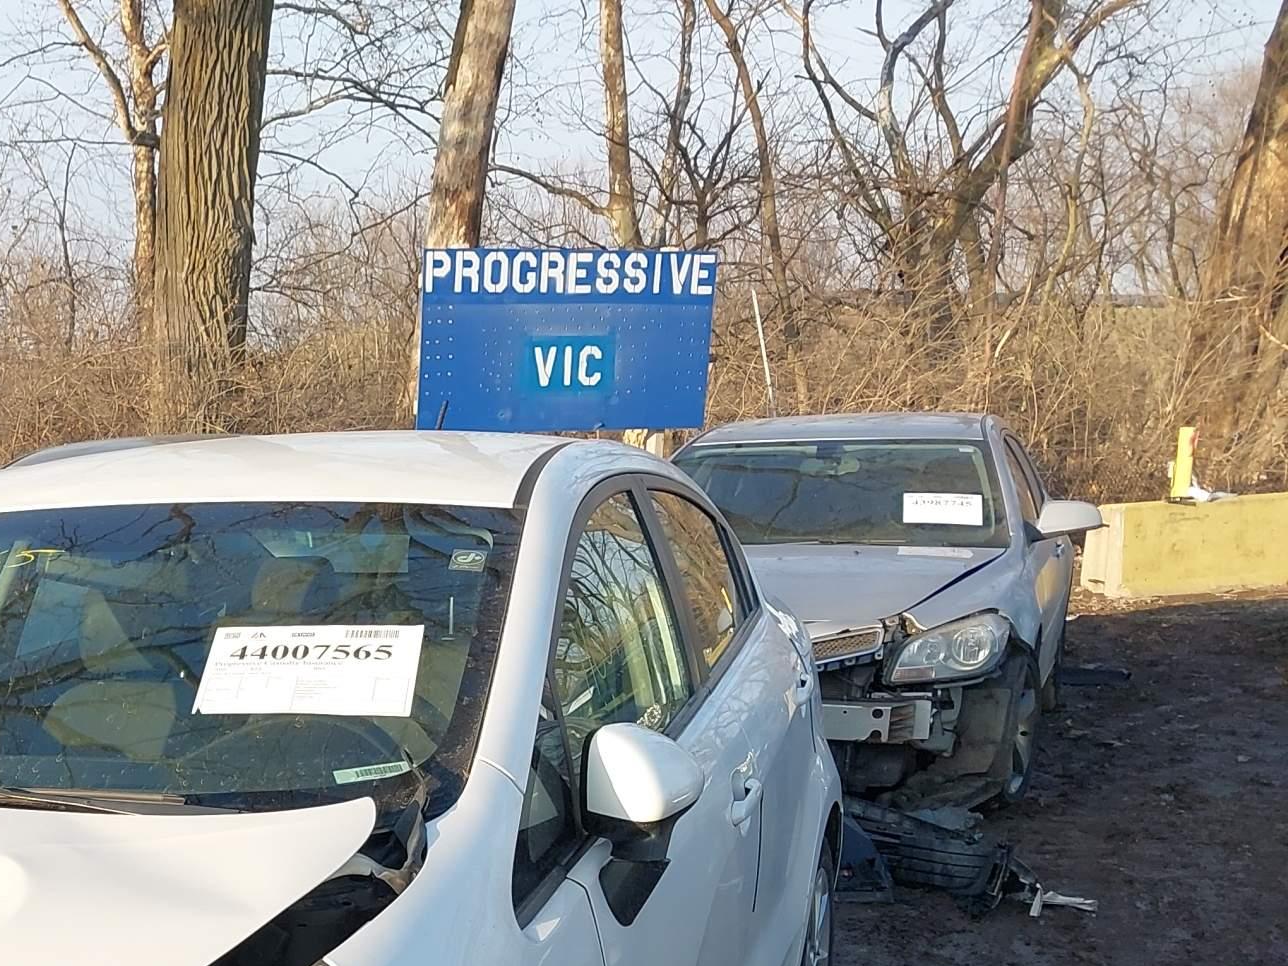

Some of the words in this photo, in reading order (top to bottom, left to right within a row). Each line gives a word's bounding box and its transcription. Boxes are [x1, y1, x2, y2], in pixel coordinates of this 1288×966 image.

[424, 250, 716, 295] PROGRESSIVE
[534, 345, 602, 387] VIC
[229, 644, 393, 660] 44007565
